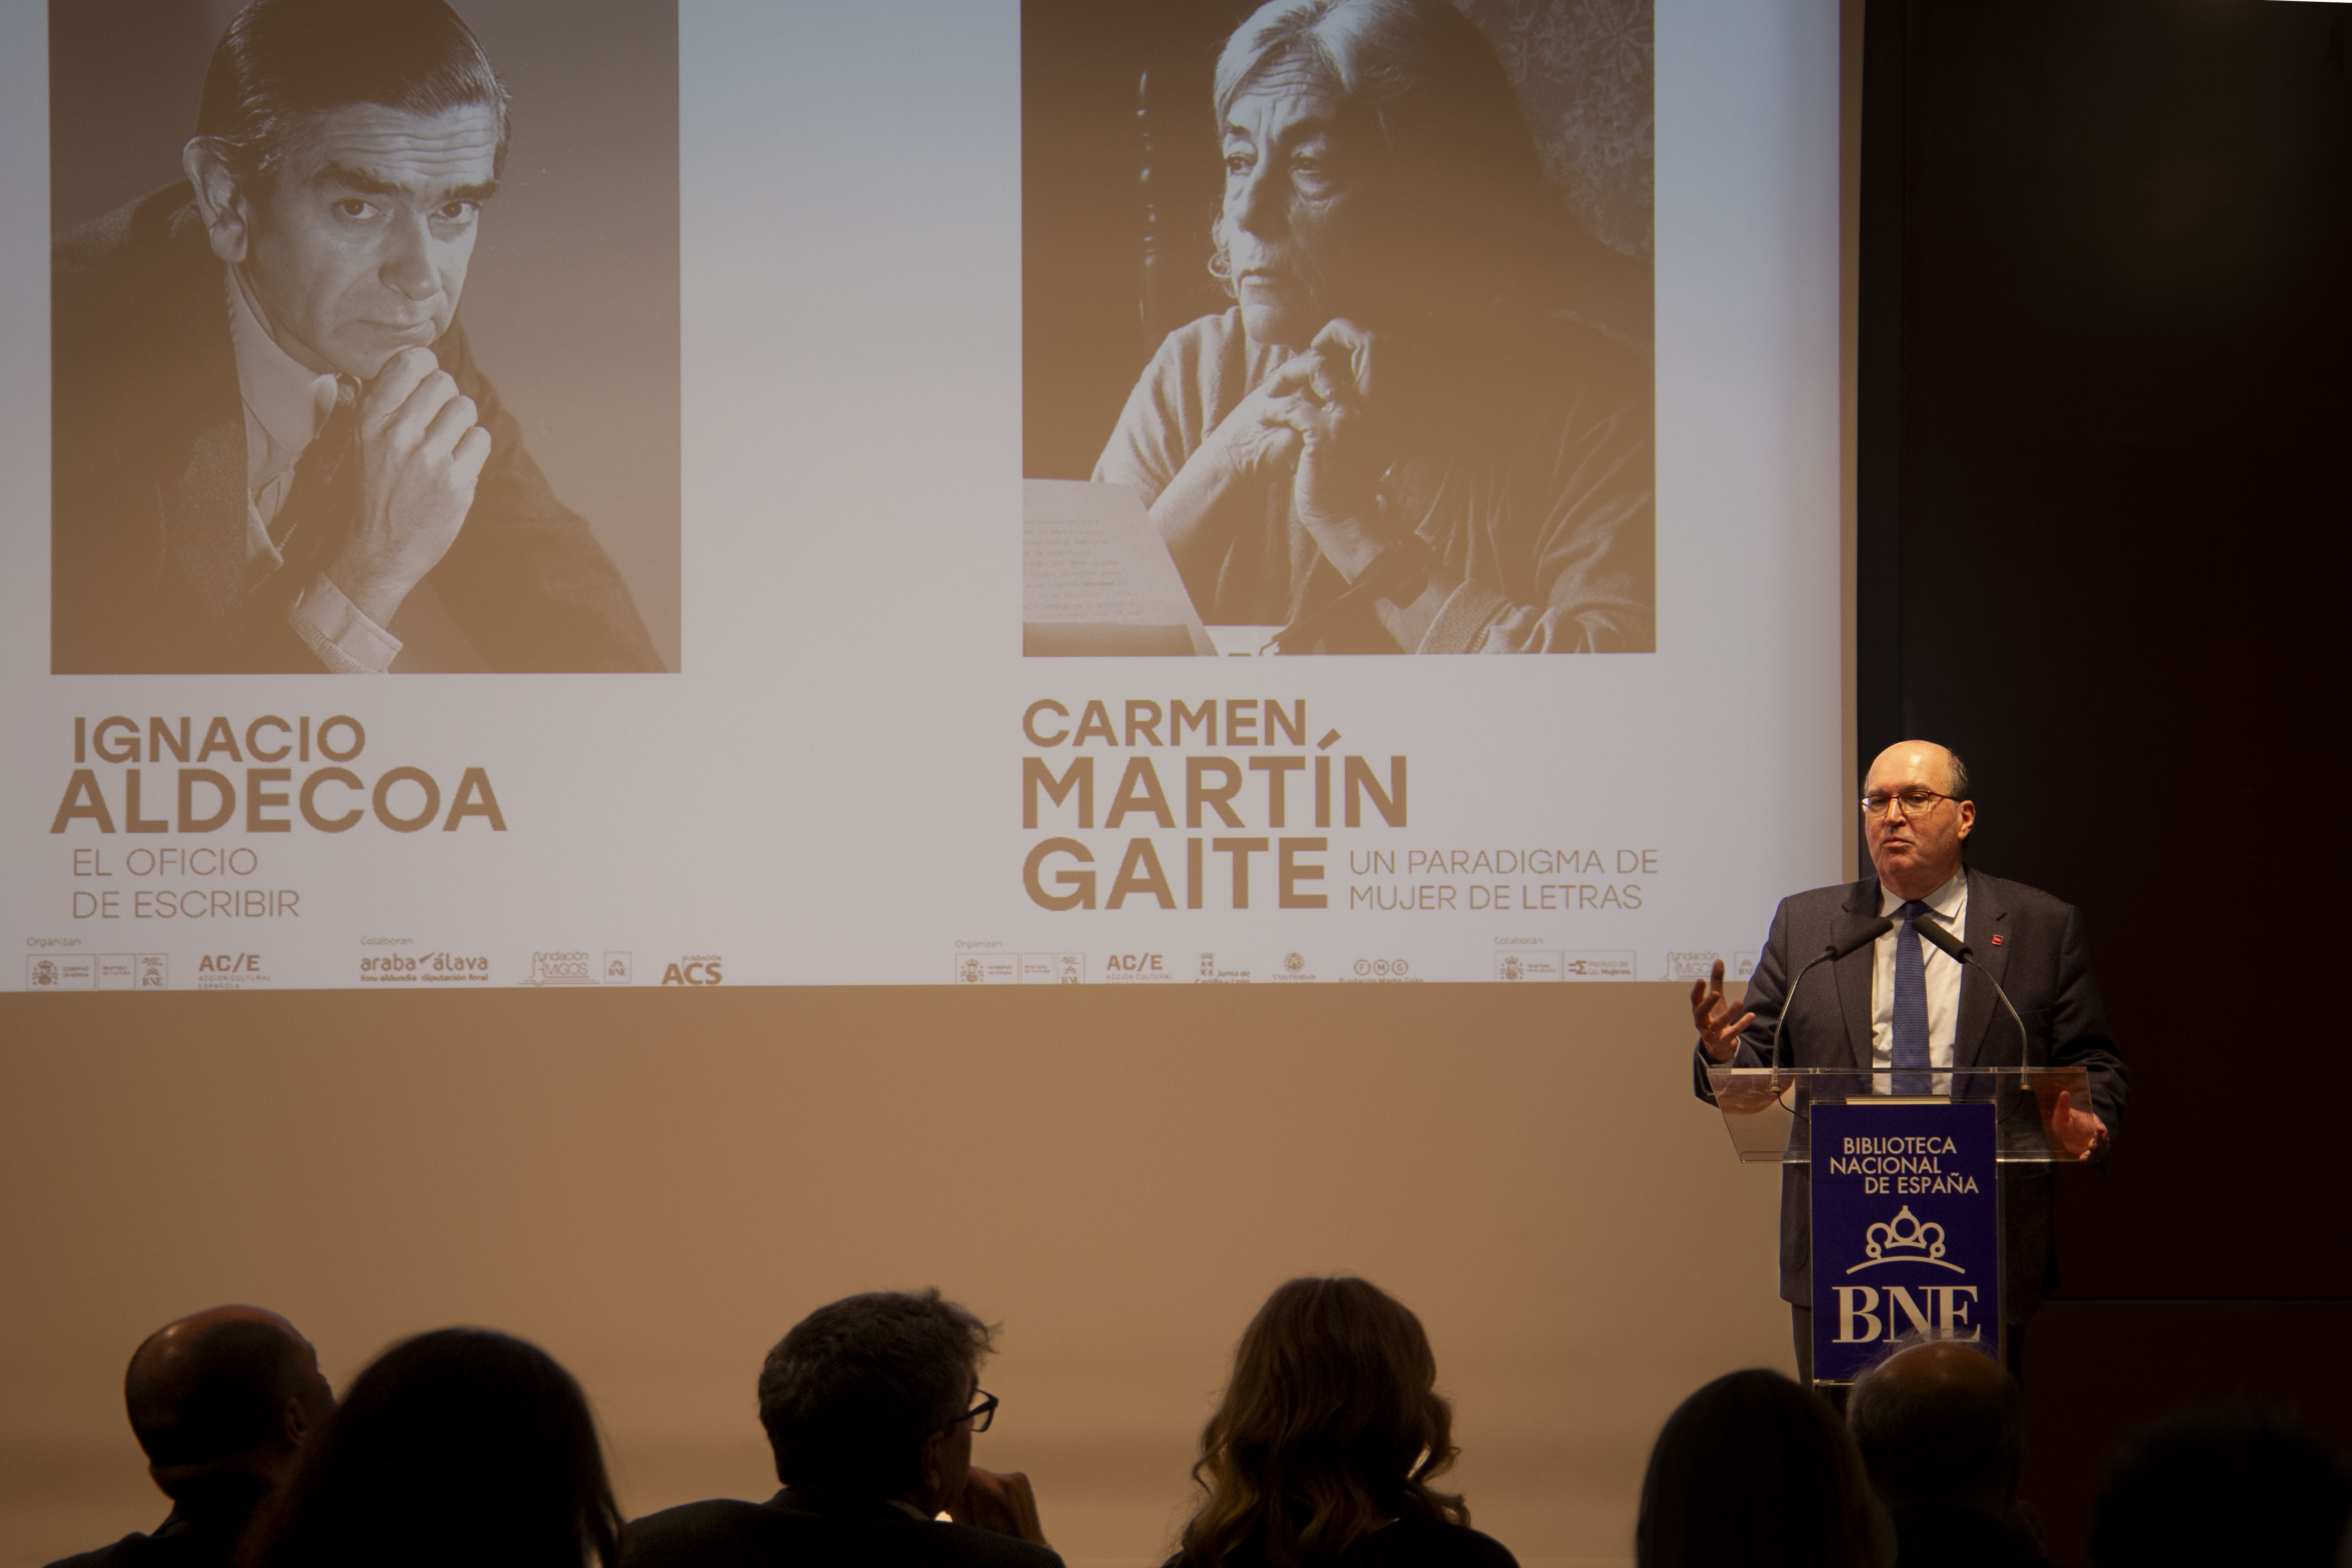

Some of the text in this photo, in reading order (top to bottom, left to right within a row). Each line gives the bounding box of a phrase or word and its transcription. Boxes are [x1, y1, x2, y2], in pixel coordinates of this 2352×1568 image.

[1023, 699, 1306, 747] CARMEN
[74, 715, 366, 763] IGNACIO
[1023, 729, 1407, 829] MARTÍN
[49, 767, 507, 834] ALDECOA
[73, 848, 257, 876] EL OFICIO
[1023, 837, 1328, 911] GAITE
[1351, 849, 1658, 875] UN PARADIGMA DE
[73, 890, 299, 919] DE ESCRIBIR
[1351, 884, 1643, 910] MUJER DE LETRAS
[27, 937, 80, 948] Organizan
[360, 936, 413, 945] Colaboran
[199, 953, 259, 972] AC/E
[360, 952, 488, 971] araba álava
[661, 962, 722, 985] ACS
[1107, 952, 1163, 972] AC/E
[1844, 1137, 1956, 1154] BIBLIOTECA
[1831, 1157, 1941, 1174] NACIONAL
[1865, 1172, 1979, 1194] DE ESPAÑA
[1832, 1286, 1980, 1343] BNE
